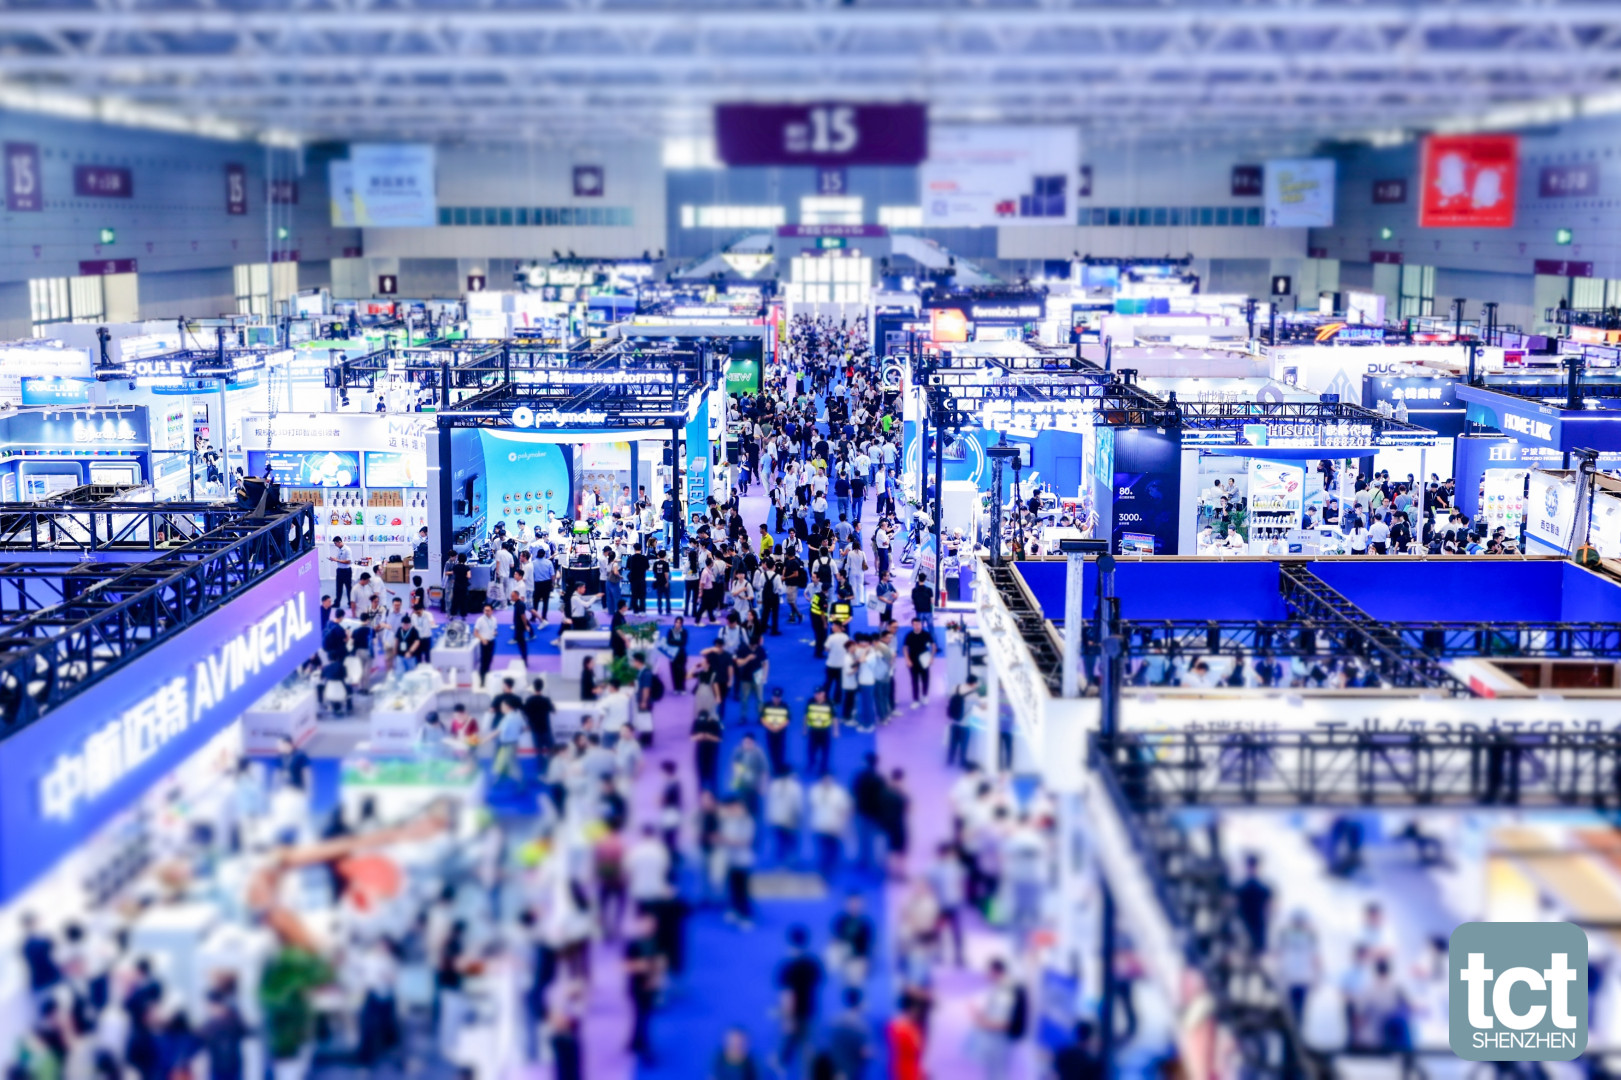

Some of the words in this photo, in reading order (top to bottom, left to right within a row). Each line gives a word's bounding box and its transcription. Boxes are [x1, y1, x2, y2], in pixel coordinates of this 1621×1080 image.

[811, 108, 858, 152] 15
[822, 173, 842, 189] 15
[535, 408, 608, 428] polymaker
[1269, 423, 1316, 437] HISUN
[1118, 513, 1143, 522] 3000+
[192, 590, 314, 723] AVIMETAL
